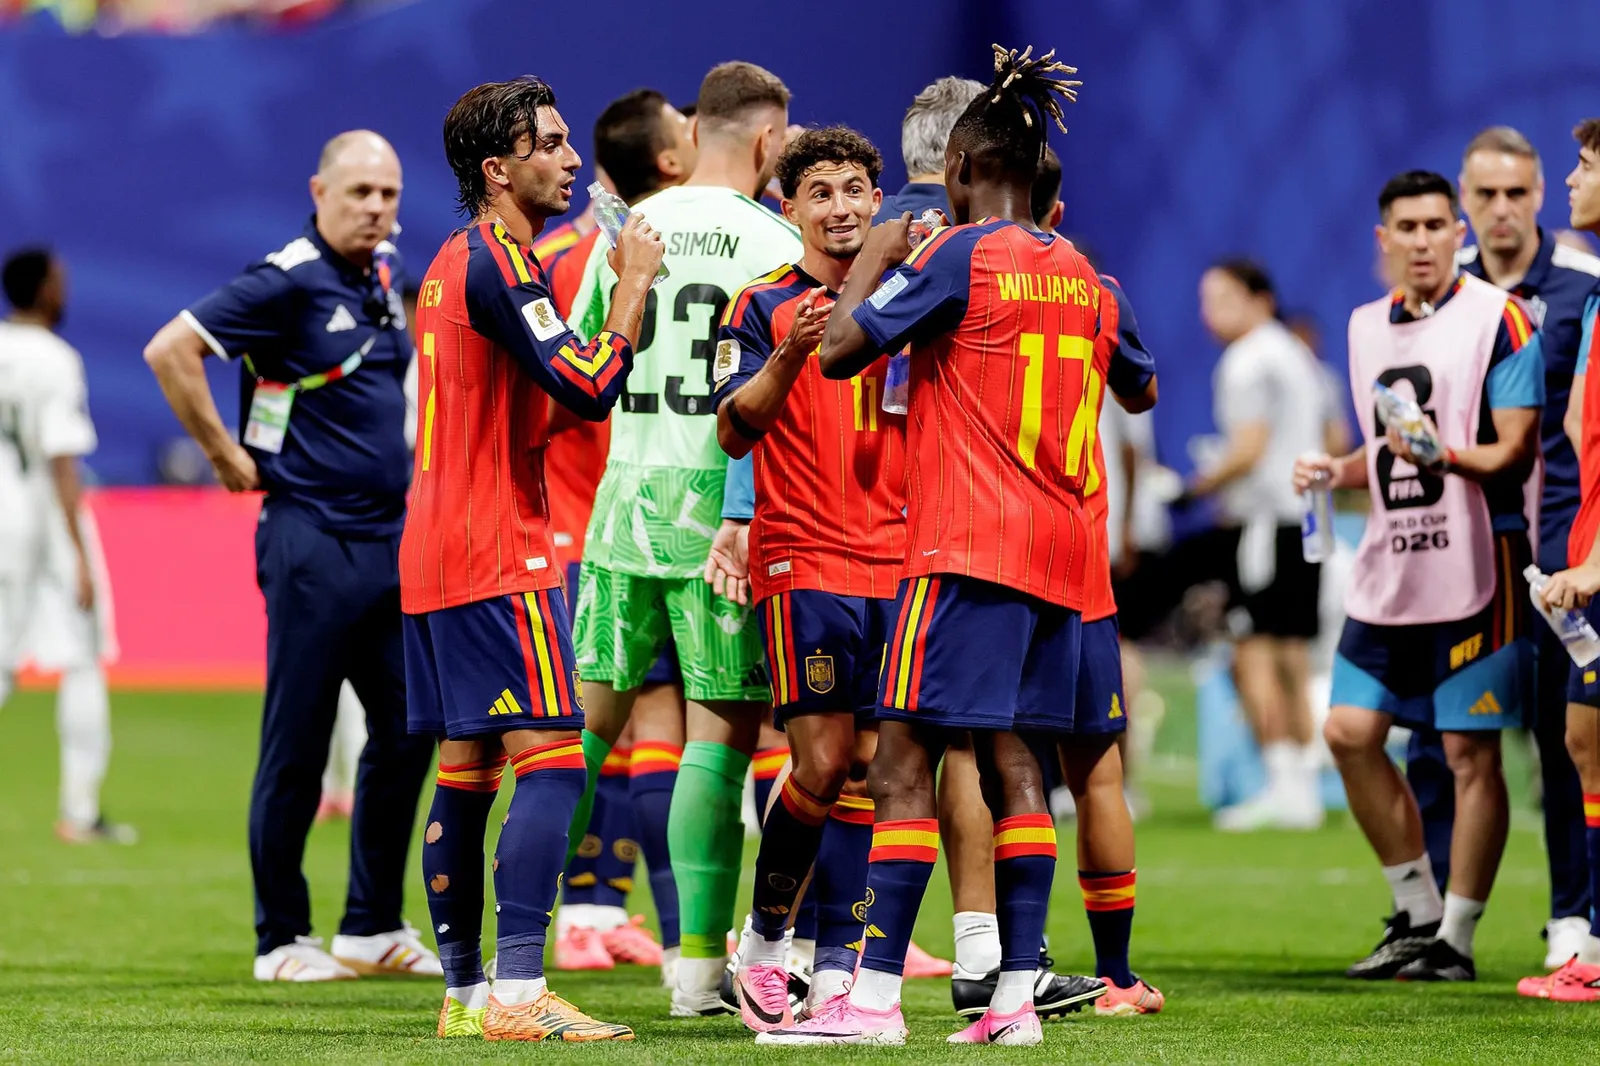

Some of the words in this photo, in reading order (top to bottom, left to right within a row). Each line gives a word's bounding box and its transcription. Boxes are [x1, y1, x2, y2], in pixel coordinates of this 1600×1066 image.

[668, 226, 740, 259] SIMÓN
[996, 273, 1089, 306] WILLIAMS
[609, 283, 730, 416] 23
[850, 375, 878, 432] 11
[1017, 332, 1094, 477] 17
[1388, 479, 1425, 501] FIFA
[1392, 530, 1449, 554] 026
